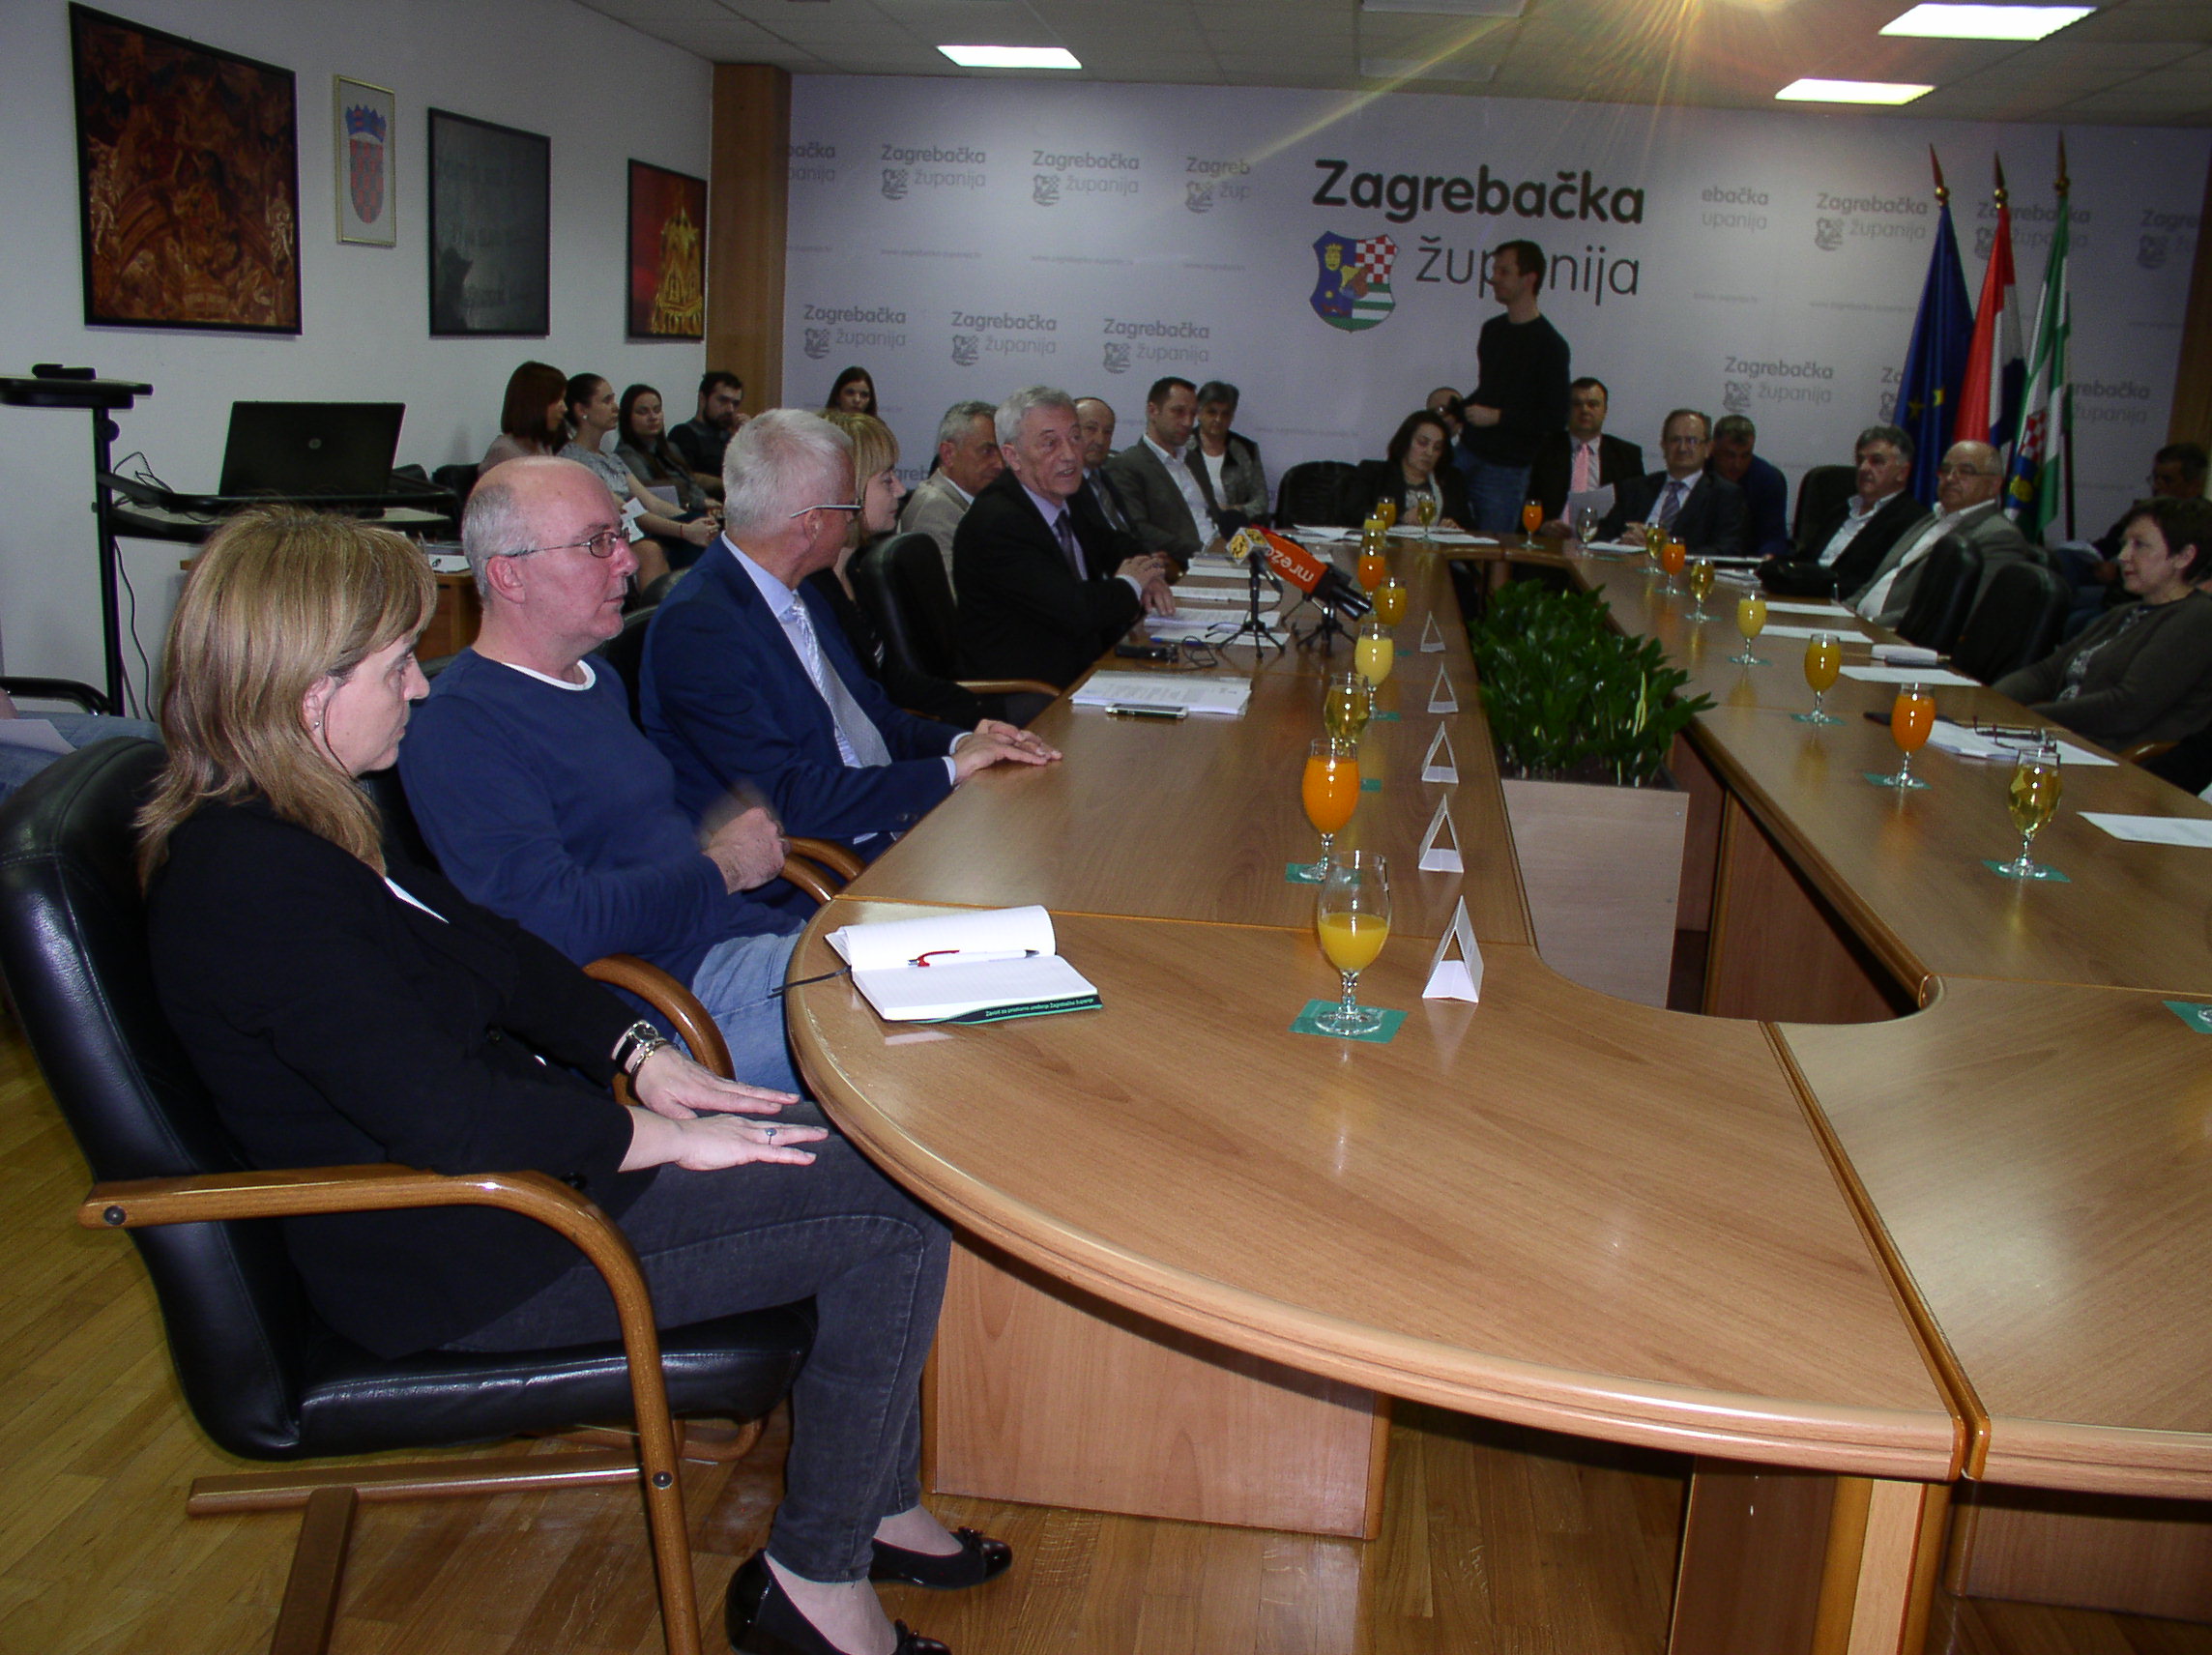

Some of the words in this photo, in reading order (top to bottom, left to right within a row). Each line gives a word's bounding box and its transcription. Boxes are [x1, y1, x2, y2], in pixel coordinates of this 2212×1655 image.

[882, 144, 985, 165] Zagrebačka
[1033, 150, 1139, 171] Zagrebačka
[913, 168, 986, 189] županija
[1065, 174, 1139, 196] županija
[1312, 160, 1644, 223] Zagrebačka
[1817, 192, 1928, 216] Zagrebačka
[1849, 218, 1926, 242] županija
[1415, 235, 1640, 306] župnija
[803, 305, 906, 325] Zagrebačka
[951, 310, 1057, 332] Zagrebačka
[835, 327, 906, 349] županija
[1103, 318, 1209, 340] Zagrebačka
[984, 334, 1057, 357] županija
[1135, 342, 1209, 364] županija
[1725, 356, 1834, 380] Zagrebačka
